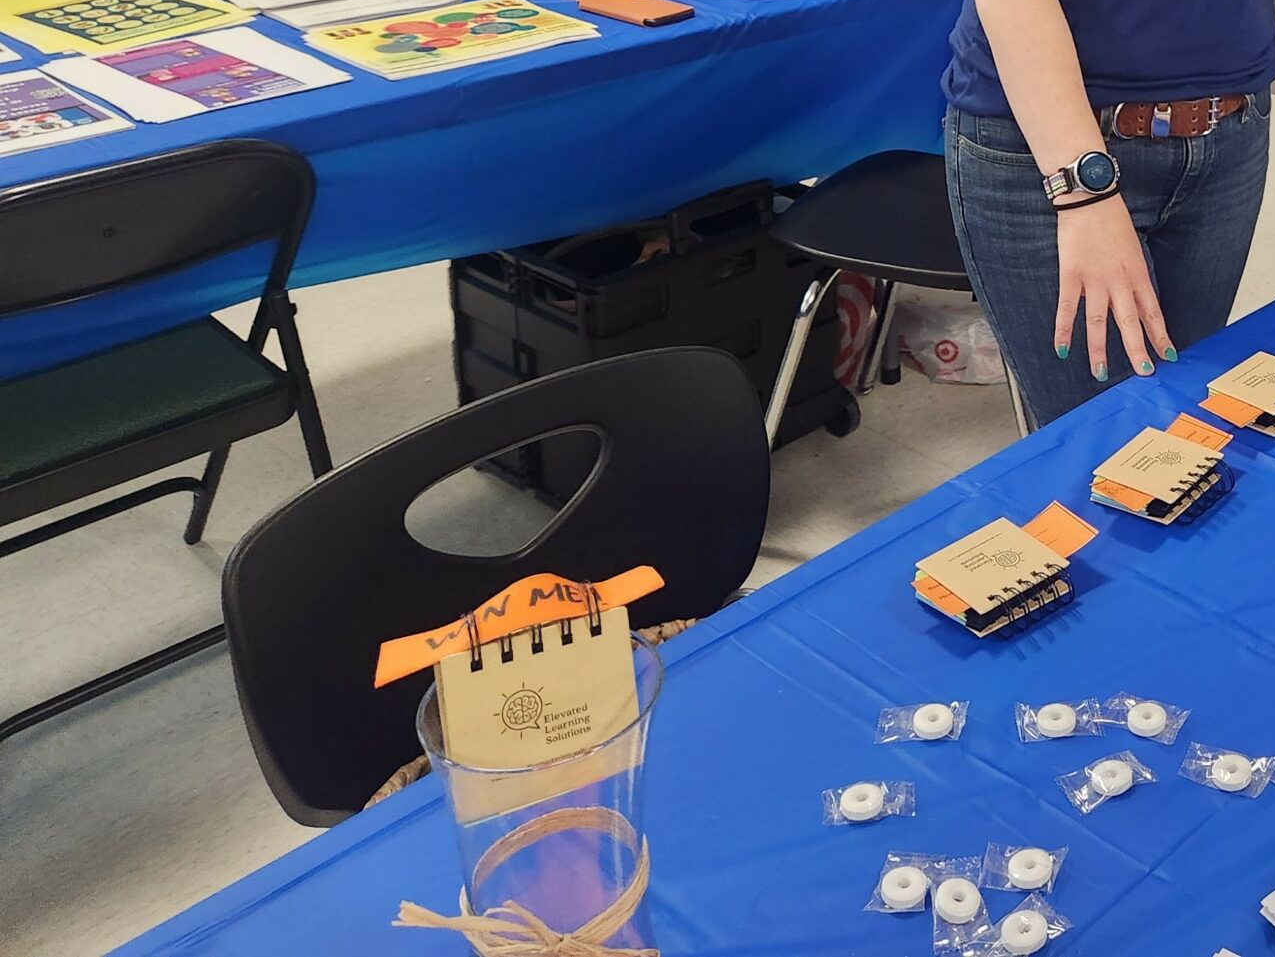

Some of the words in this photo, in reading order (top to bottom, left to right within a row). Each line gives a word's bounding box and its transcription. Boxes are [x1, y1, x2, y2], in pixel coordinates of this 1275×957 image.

[543, 703, 588, 723] Elevated
[545, 715, 591, 734] Learning
[546, 724, 591, 744] Solutions
